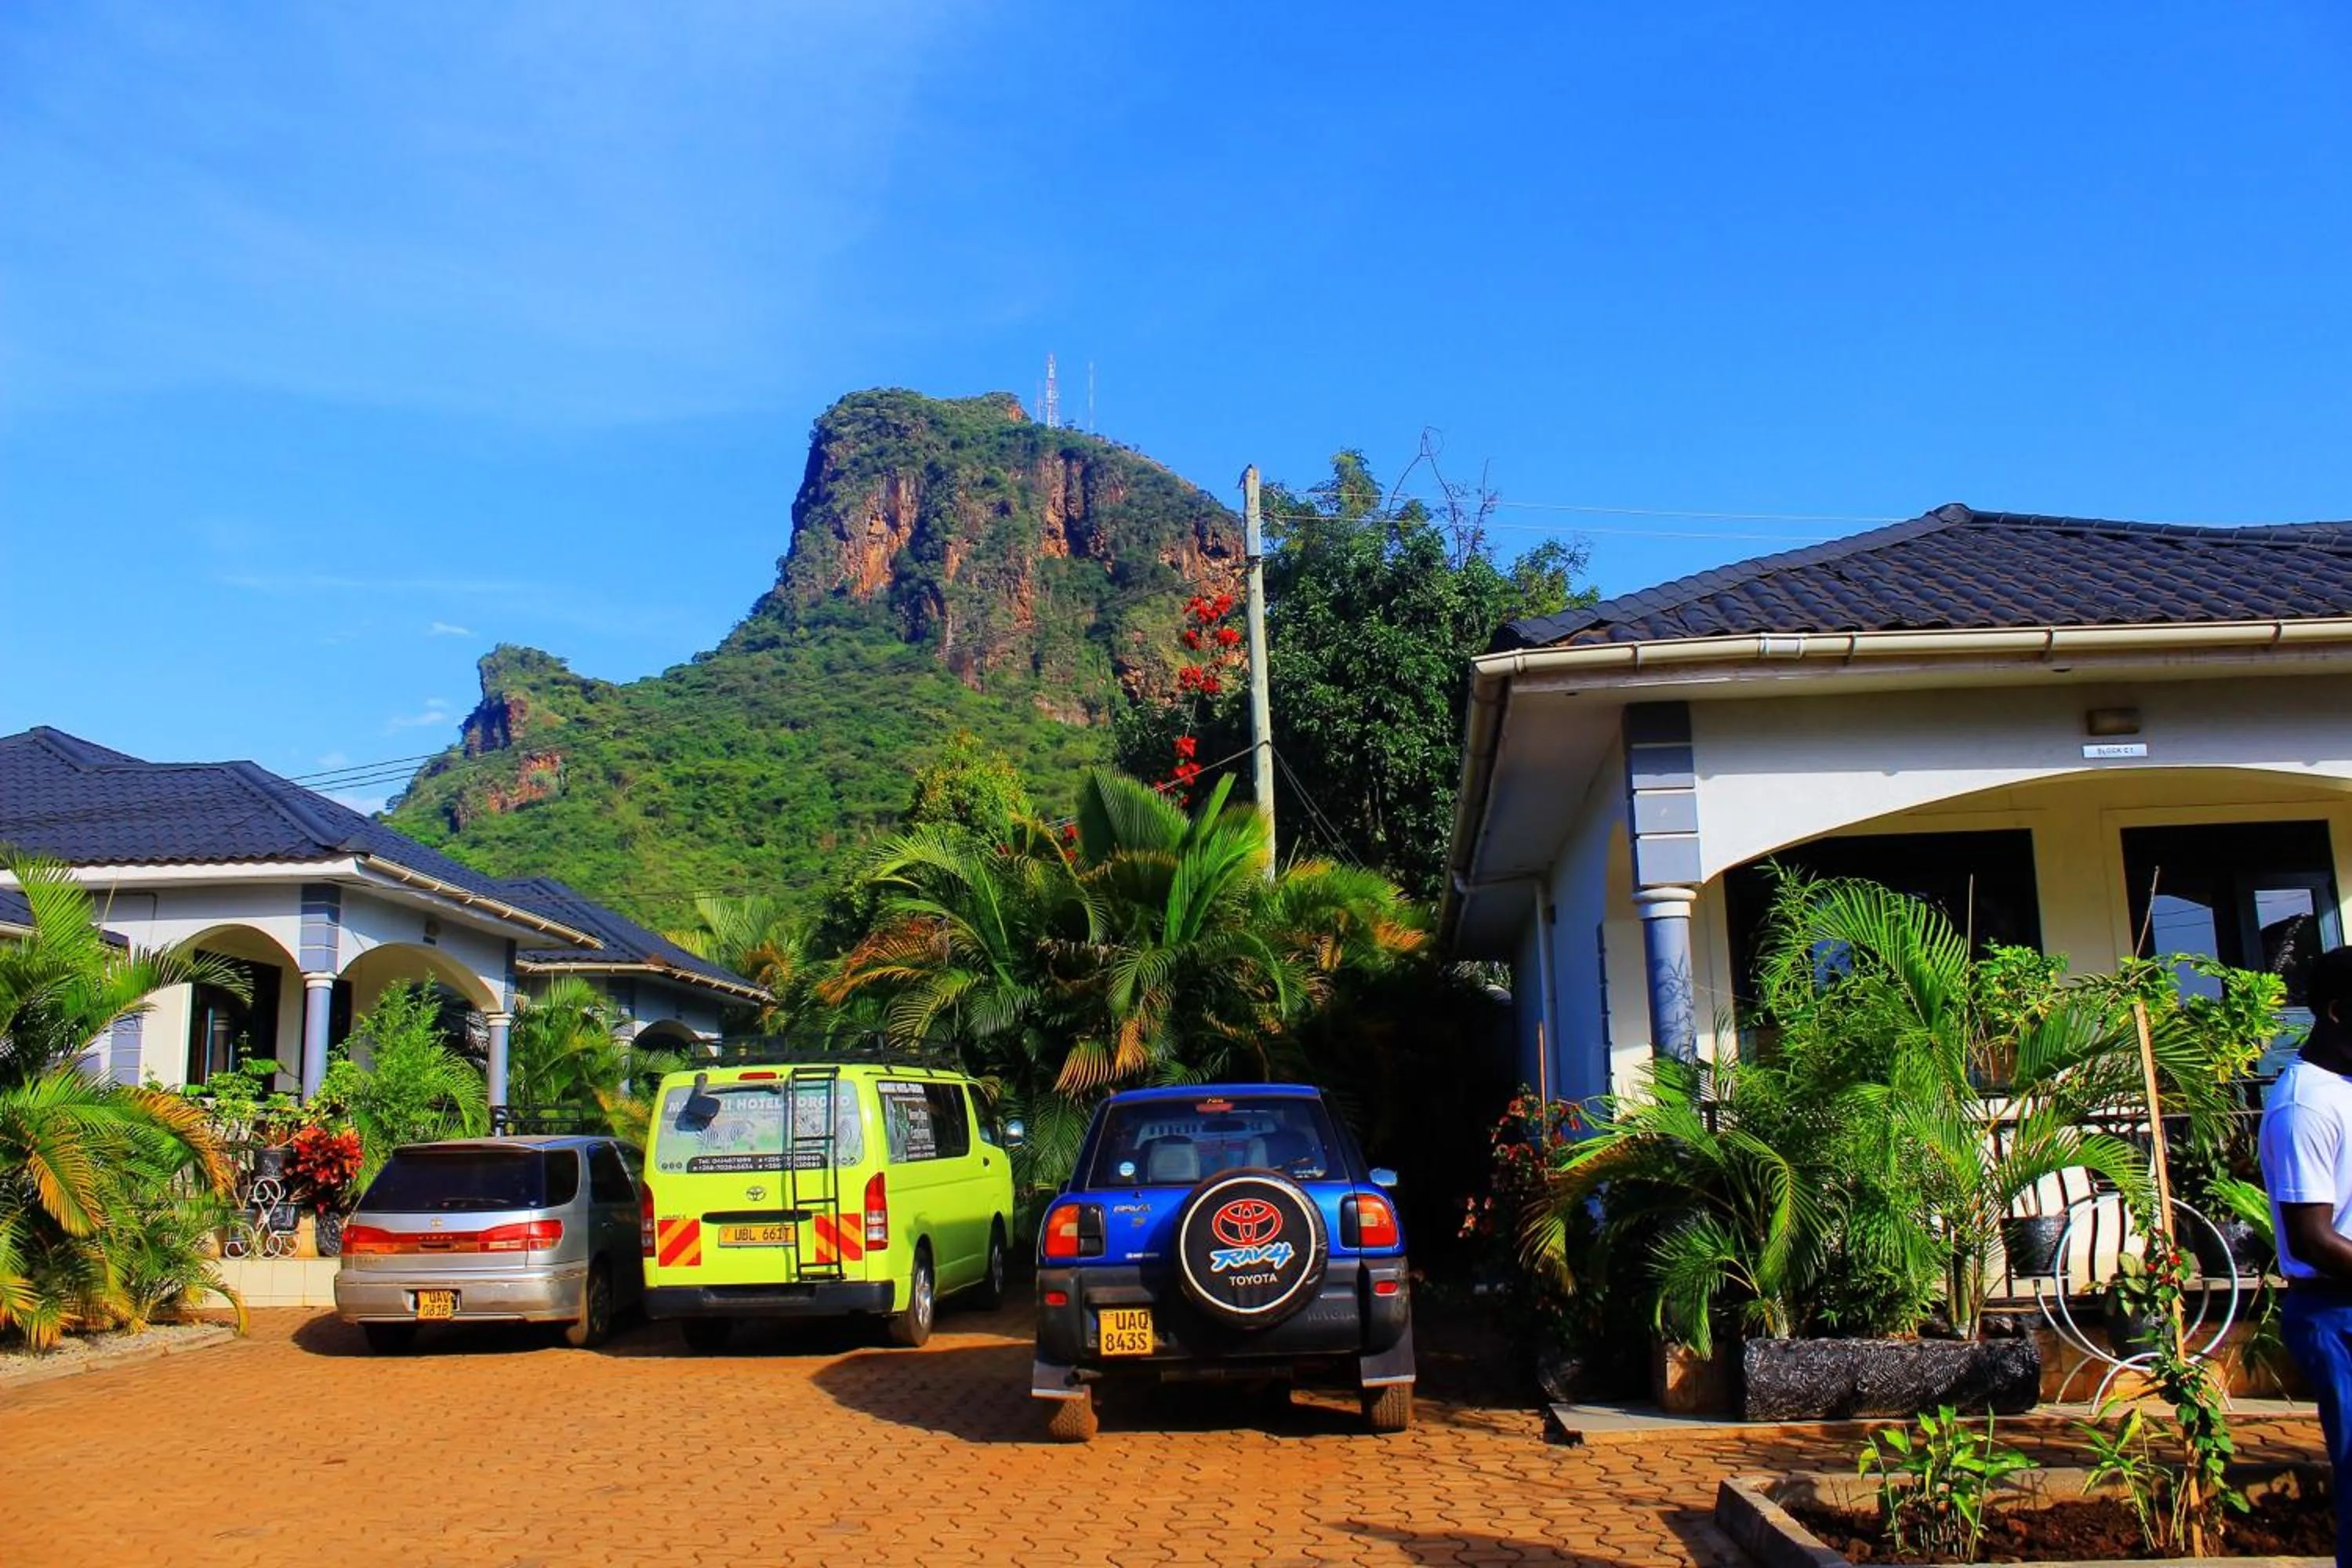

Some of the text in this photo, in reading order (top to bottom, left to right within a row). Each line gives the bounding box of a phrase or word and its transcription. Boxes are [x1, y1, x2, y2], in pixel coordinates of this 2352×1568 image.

[736, 1097, 783, 1110] HOTEL
[735, 1227, 757, 1241] UBL
[1229, 1273, 1278, 1286] TOYOTA
[1116, 1312, 1149, 1330] UAQ
[1105, 1332, 1147, 1352] 843S
